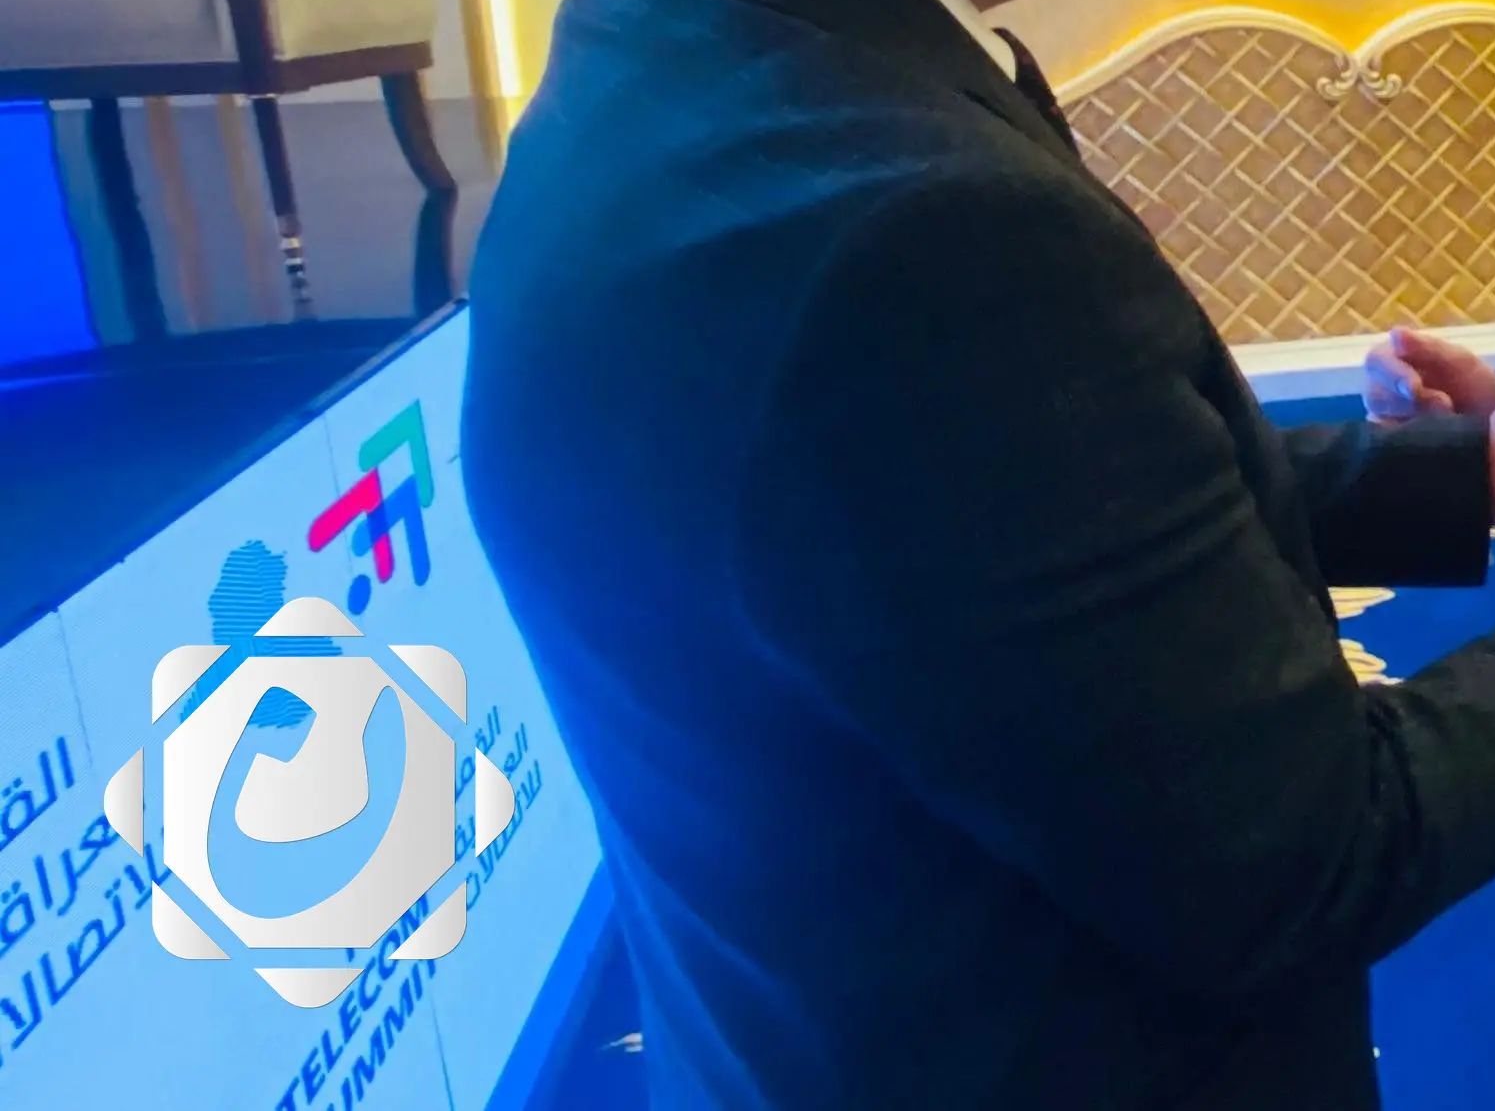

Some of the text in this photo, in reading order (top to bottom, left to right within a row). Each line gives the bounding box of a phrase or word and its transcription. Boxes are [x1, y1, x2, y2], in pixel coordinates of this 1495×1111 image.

[0, 736, 75, 852] الق
[455, 705, 501, 803] القم
[275, 893, 429, 1111] TELECOM
[326, 959, 436, 1111] UMMI
